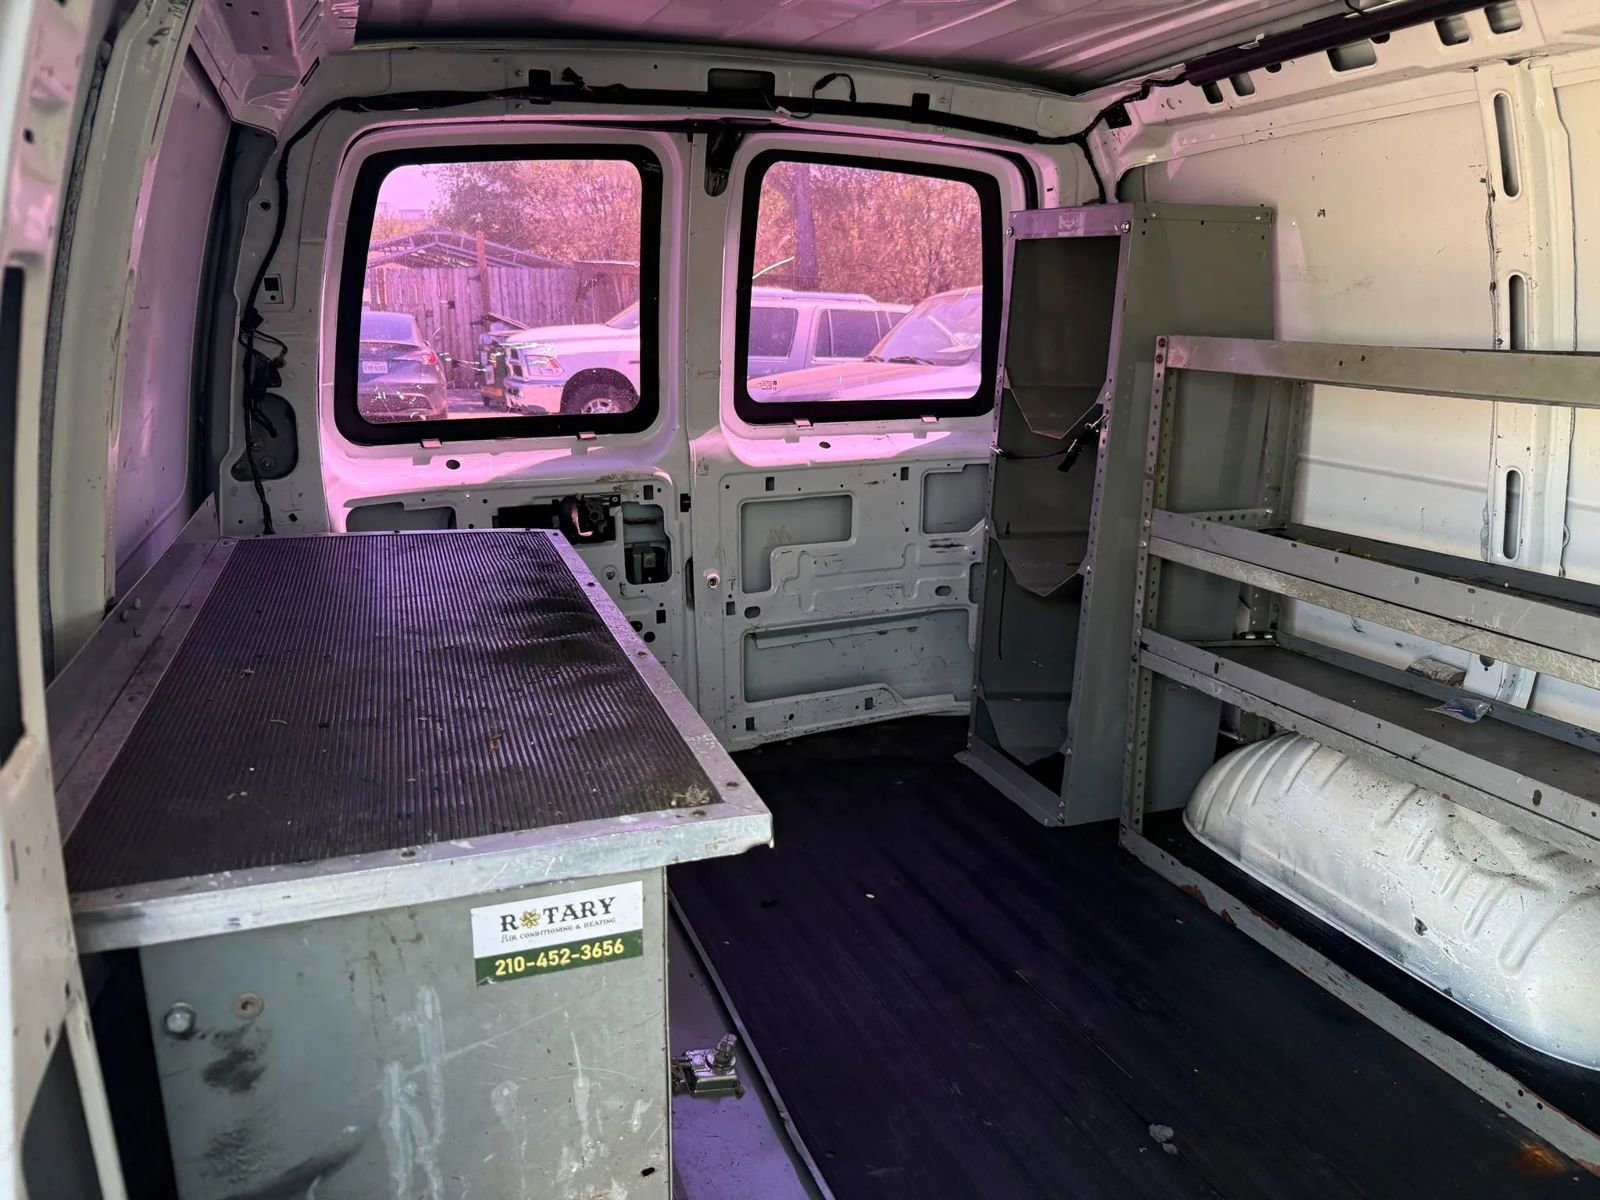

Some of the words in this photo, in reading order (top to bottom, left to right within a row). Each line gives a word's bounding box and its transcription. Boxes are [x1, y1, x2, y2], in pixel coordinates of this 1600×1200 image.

[519, 924, 573, 940] CONDITIONING
[583, 918, 616, 929] HEATING
[494, 938, 625, 977] 210-452-3656
